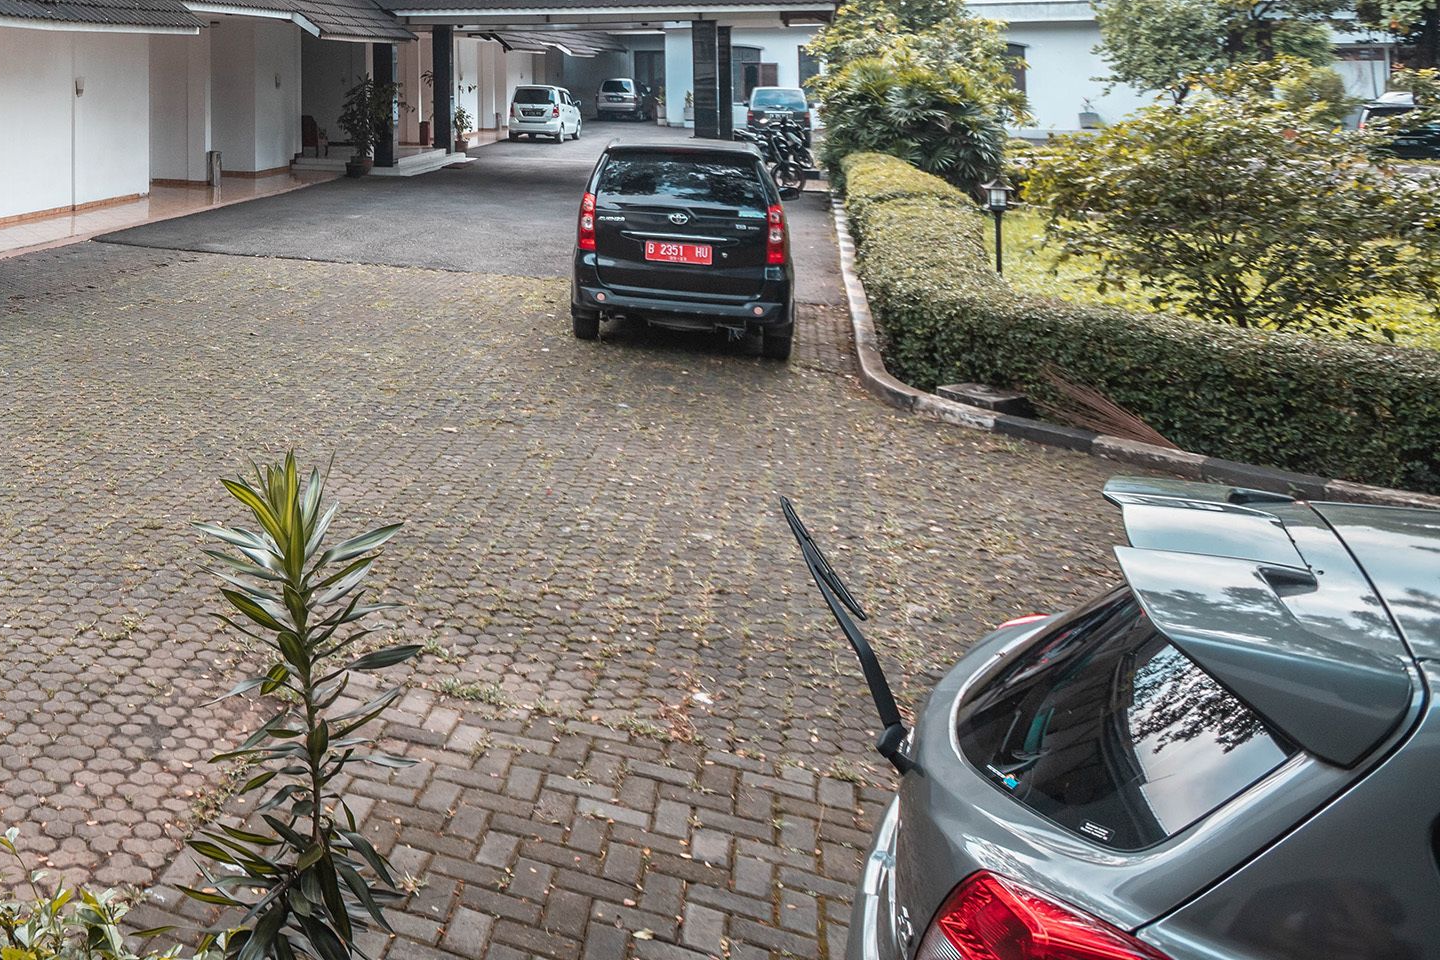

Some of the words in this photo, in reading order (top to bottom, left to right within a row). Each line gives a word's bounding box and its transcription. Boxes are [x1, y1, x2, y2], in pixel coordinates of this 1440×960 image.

[648, 243, 655, 254] B
[660, 244, 683, 256] 2351
[695, 246, 708, 258] HU
